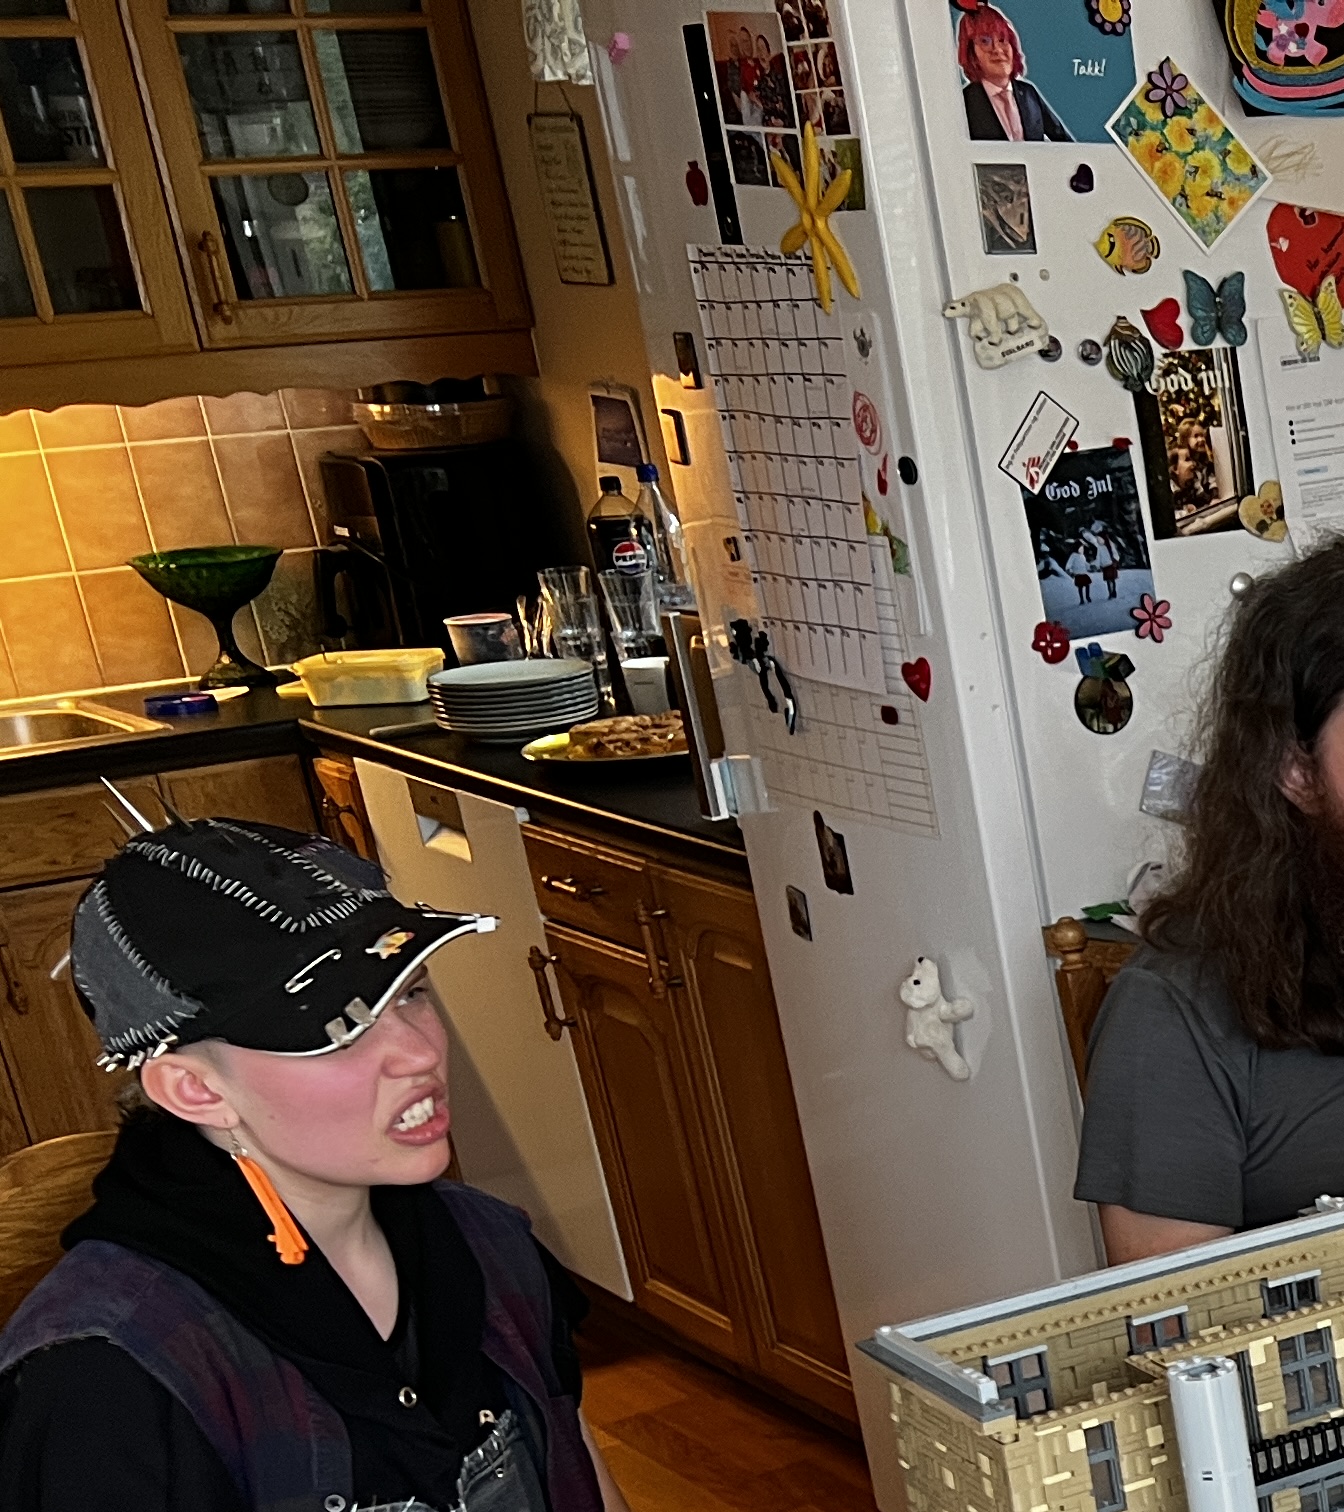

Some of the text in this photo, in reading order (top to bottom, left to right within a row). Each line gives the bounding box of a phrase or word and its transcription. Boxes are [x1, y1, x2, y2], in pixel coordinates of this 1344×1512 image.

[1072, 58, 1106, 77] Takk!
[1145, 367, 1193, 395] God
[1045, 474, 1113, 501] God Jul
